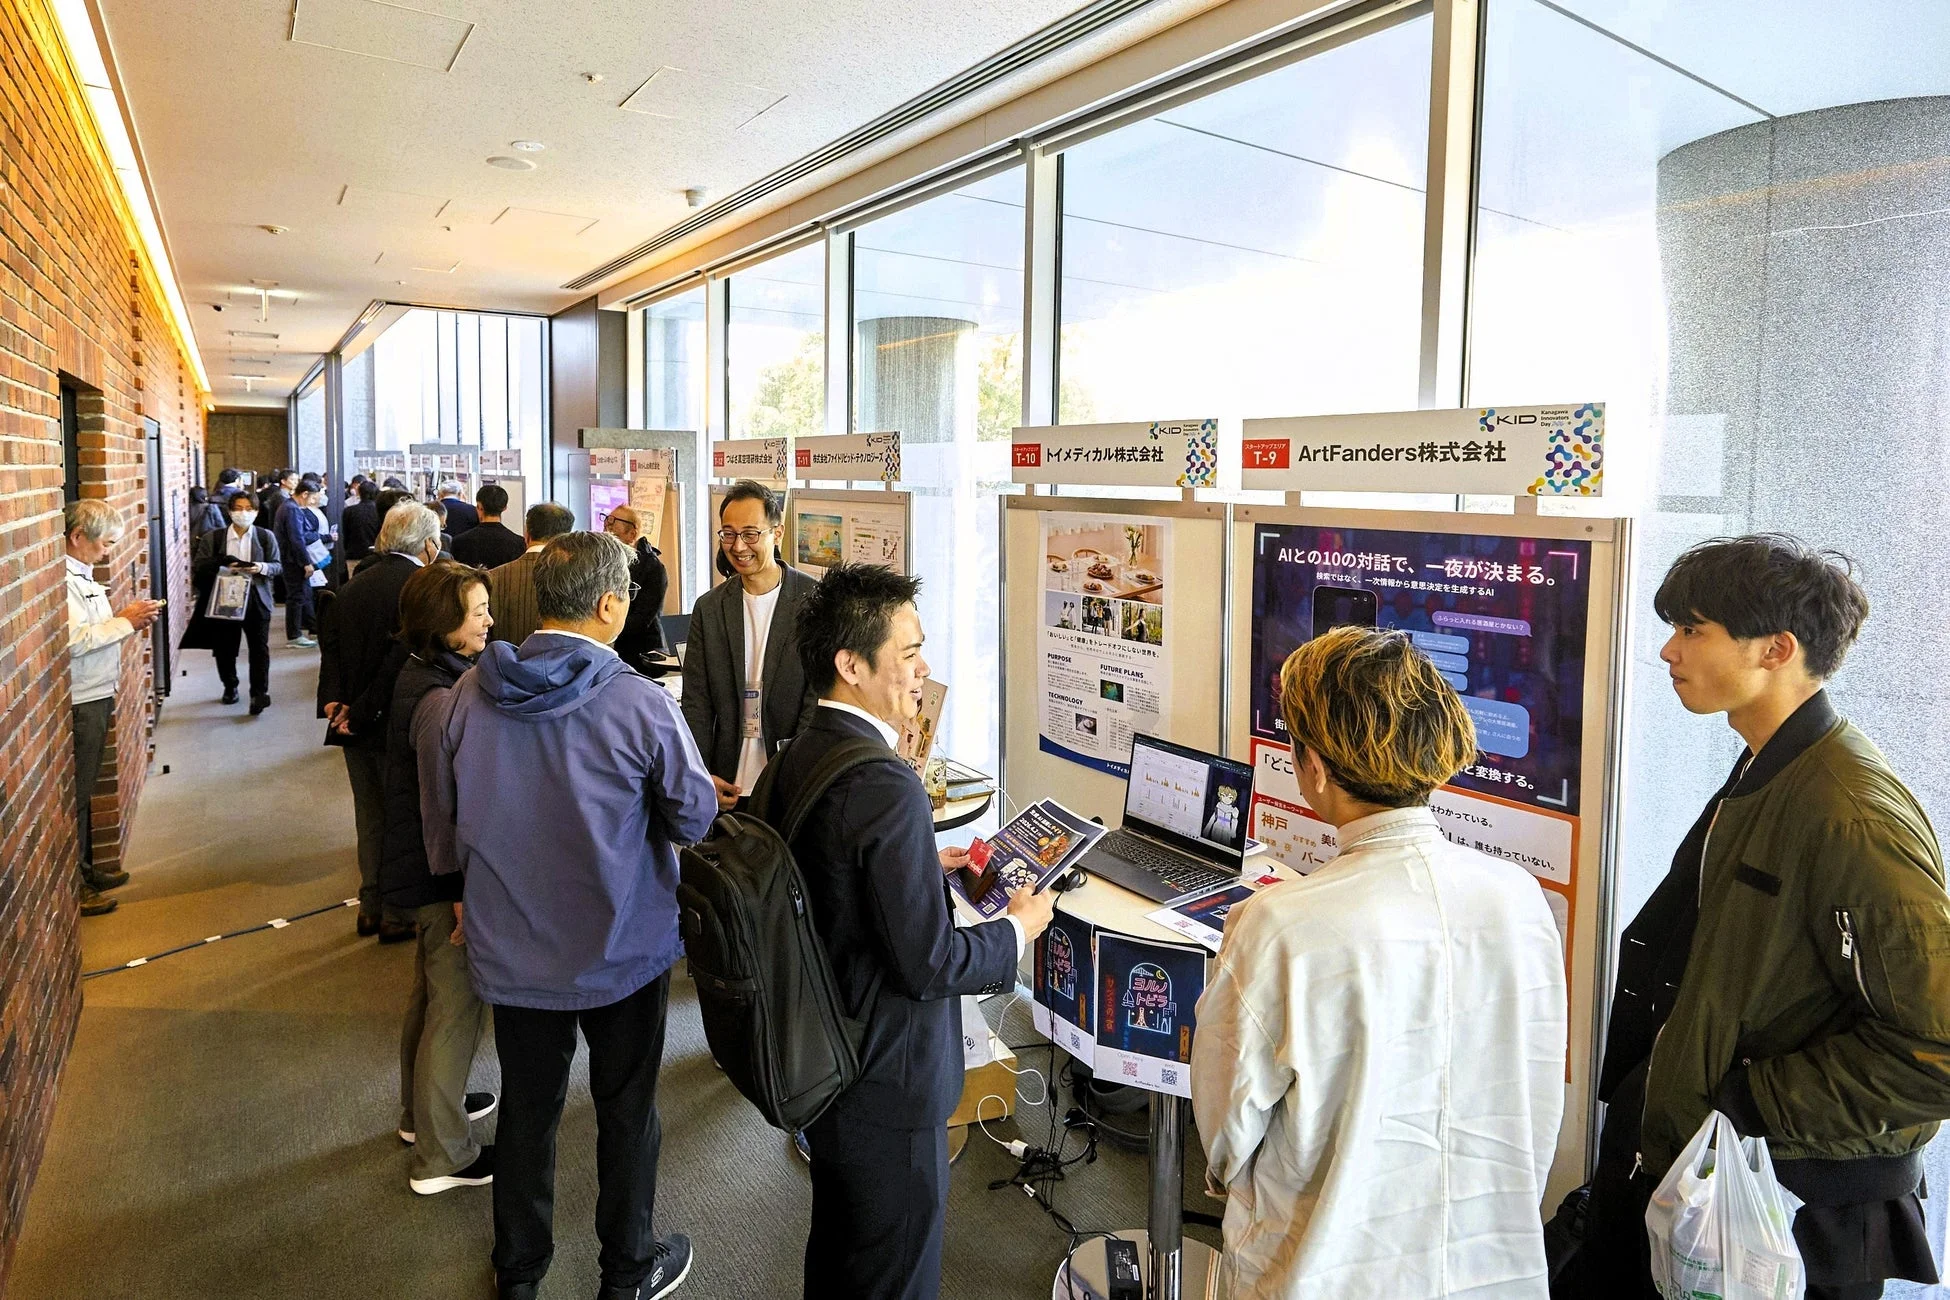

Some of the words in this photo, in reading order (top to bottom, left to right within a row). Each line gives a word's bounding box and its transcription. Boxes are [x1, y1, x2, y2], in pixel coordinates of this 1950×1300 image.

[1496, 414, 1538, 426] KID
[1016, 452, 1036, 464] T-10
[1046, 446, 1164, 463] トイメディカル株式会社
[1253, 451, 1278, 466] T-9
[1298, 440, 1507, 463] ArtFanders株式会社
[1278, 547, 1557, 587] AIとの10の対話で、一夜が決まる。
[1316, 572, 1494, 598] 検索ではなく、一次情報から意思決定を生成するAI
[1047, 652, 1072, 664] PURPOSE
[1100, 663, 1122, 674] FUTURE
[1123, 668, 1144, 679] PLANS
[1048, 691, 1083, 706] TECHNOLOGY
[1274, 718, 1288, 731] 街
[1460, 764, 1535, 791] と変換する。
[1261, 811, 1288, 830] 神戸
[1292, 834, 1317, 848] おすすめ
[1302, 851, 1326, 864] バー
[1132, 977, 1168, 994] ヨルノ
[1135, 992, 1168, 1008] トビラ
